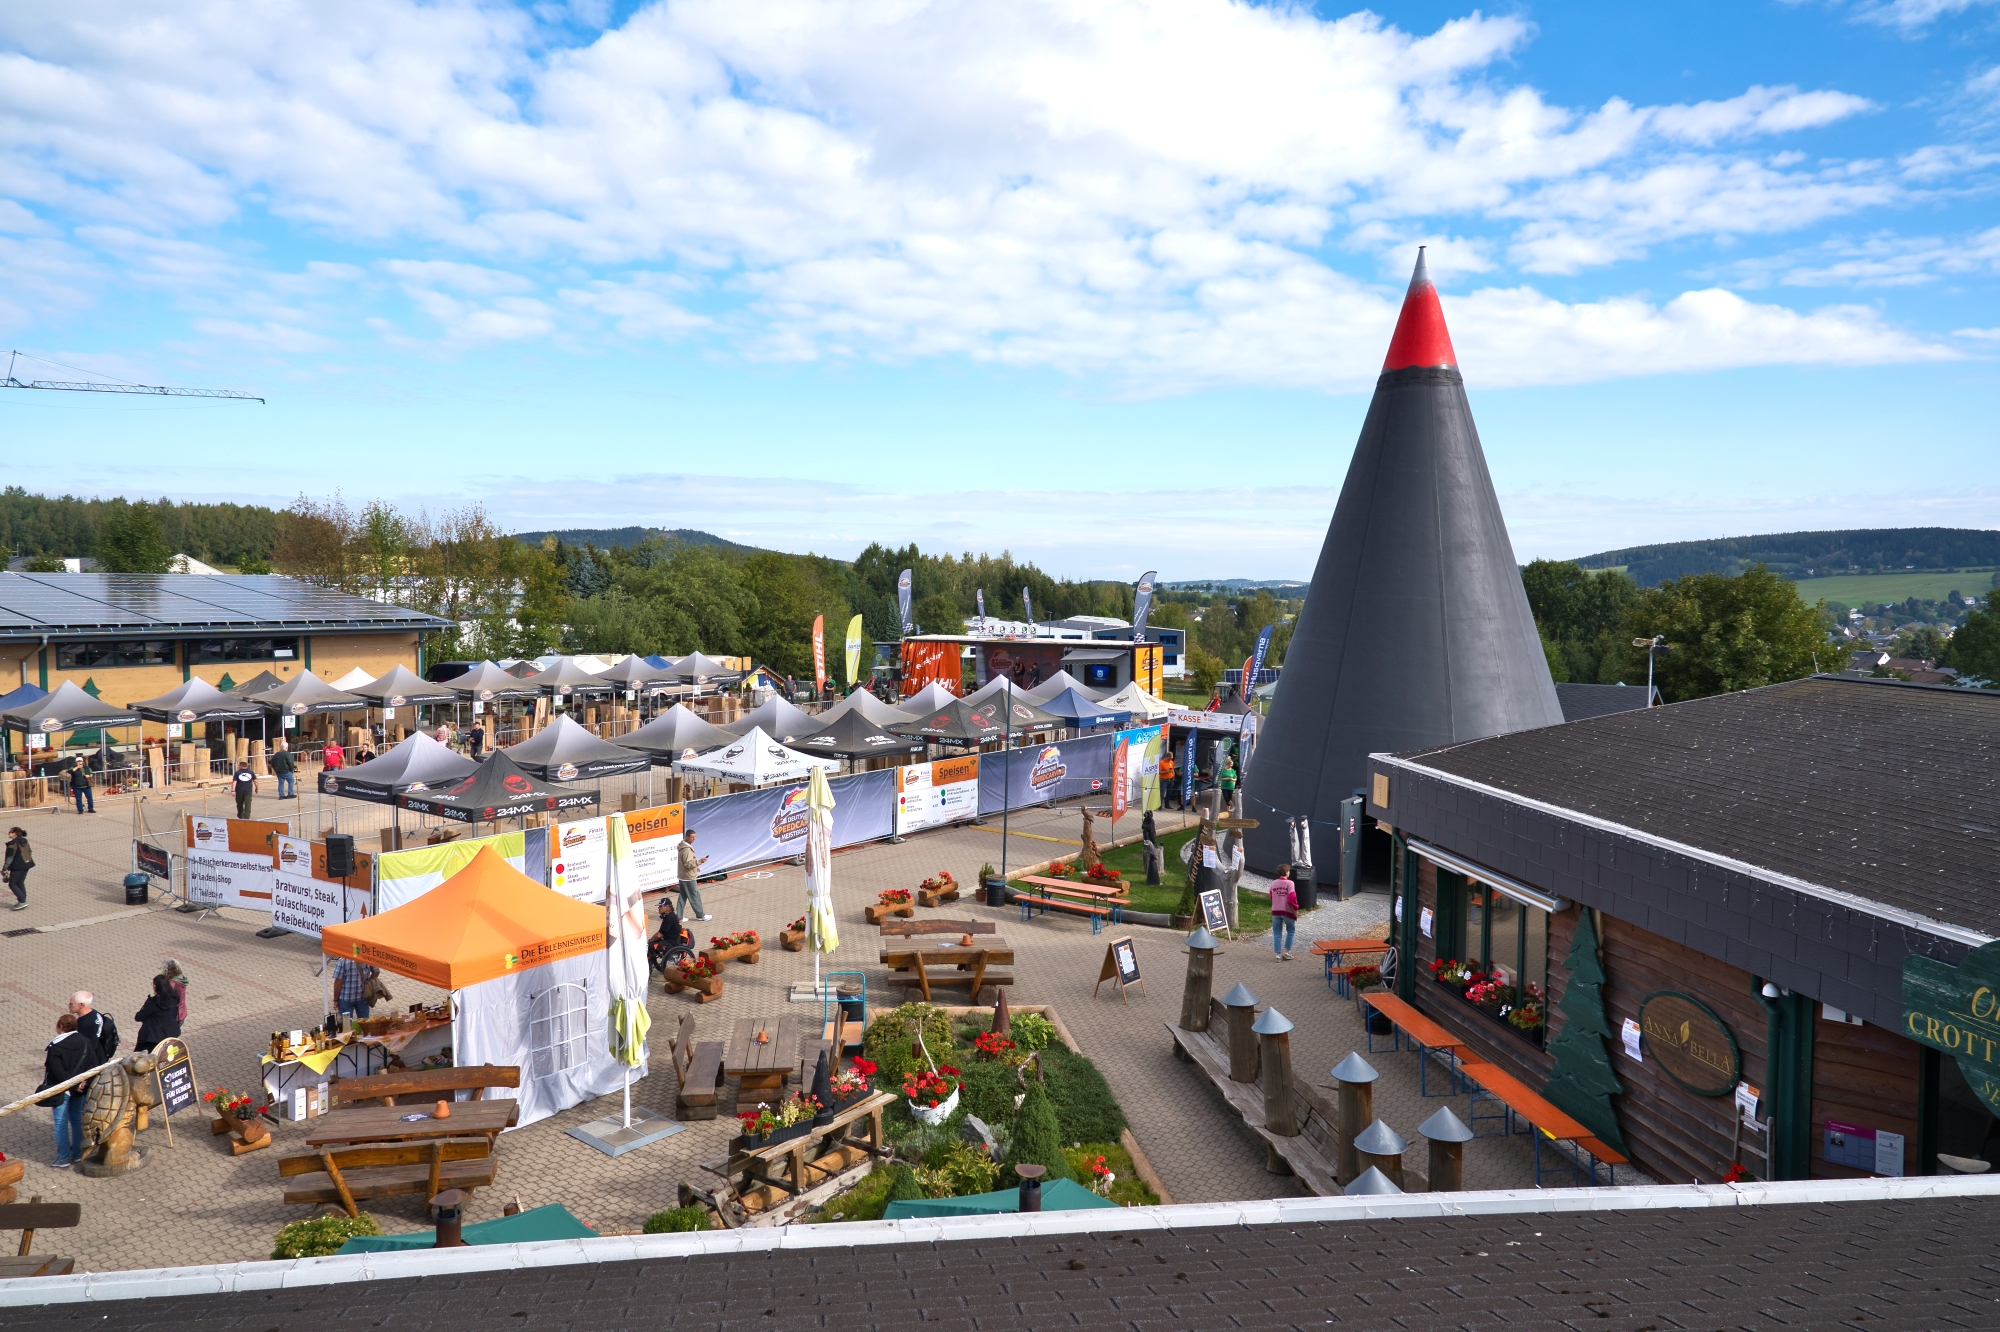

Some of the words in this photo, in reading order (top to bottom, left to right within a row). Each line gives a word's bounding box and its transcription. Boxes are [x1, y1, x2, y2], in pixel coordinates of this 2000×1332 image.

[814, 631, 825, 680] STIHL
[1249, 637, 1266, 685] Husqvarna
[1178, 714, 1201, 724] KASSE
[938, 737, 963, 745] 24MX
[980, 734, 998, 743] 24MX
[1186, 738, 1194, 788] Husqvarna
[727, 773, 746, 781] 24MX
[769, 771, 789, 780] 24MX
[939, 765, 969, 779] Speisen
[1032, 767, 1065, 784] SPEEDCARVING
[1116, 756, 1125, 811] STIHL
[408, 800, 430, 812] 24MX
[558, 796, 593, 807] 24MX
[444, 807, 467, 820] 24MX
[496, 804, 534, 817] 24MX
[787, 812, 806, 823] DEUTSC
[627, 817, 668, 833] peisen
[198, 856, 240, 869] Räucherkerzen
[240, 861, 258, 872] selbst
[276, 878, 313, 900] Bratwurst,
[314, 888, 339, 906] Steak,
[275, 894, 325, 919] Gulaschsuppe
[274, 910, 279, 922] &
[281, 911, 323, 934] Reibekuche
[1644, 1016, 1678, 1045] ANNA
[1908, 1011, 2000, 1066] CROTT
[1690, 1042, 1731, 1072] BELLA
[165, 1088, 176, 1100] FÜR
[172, 1092, 189, 1106] BESUCH
